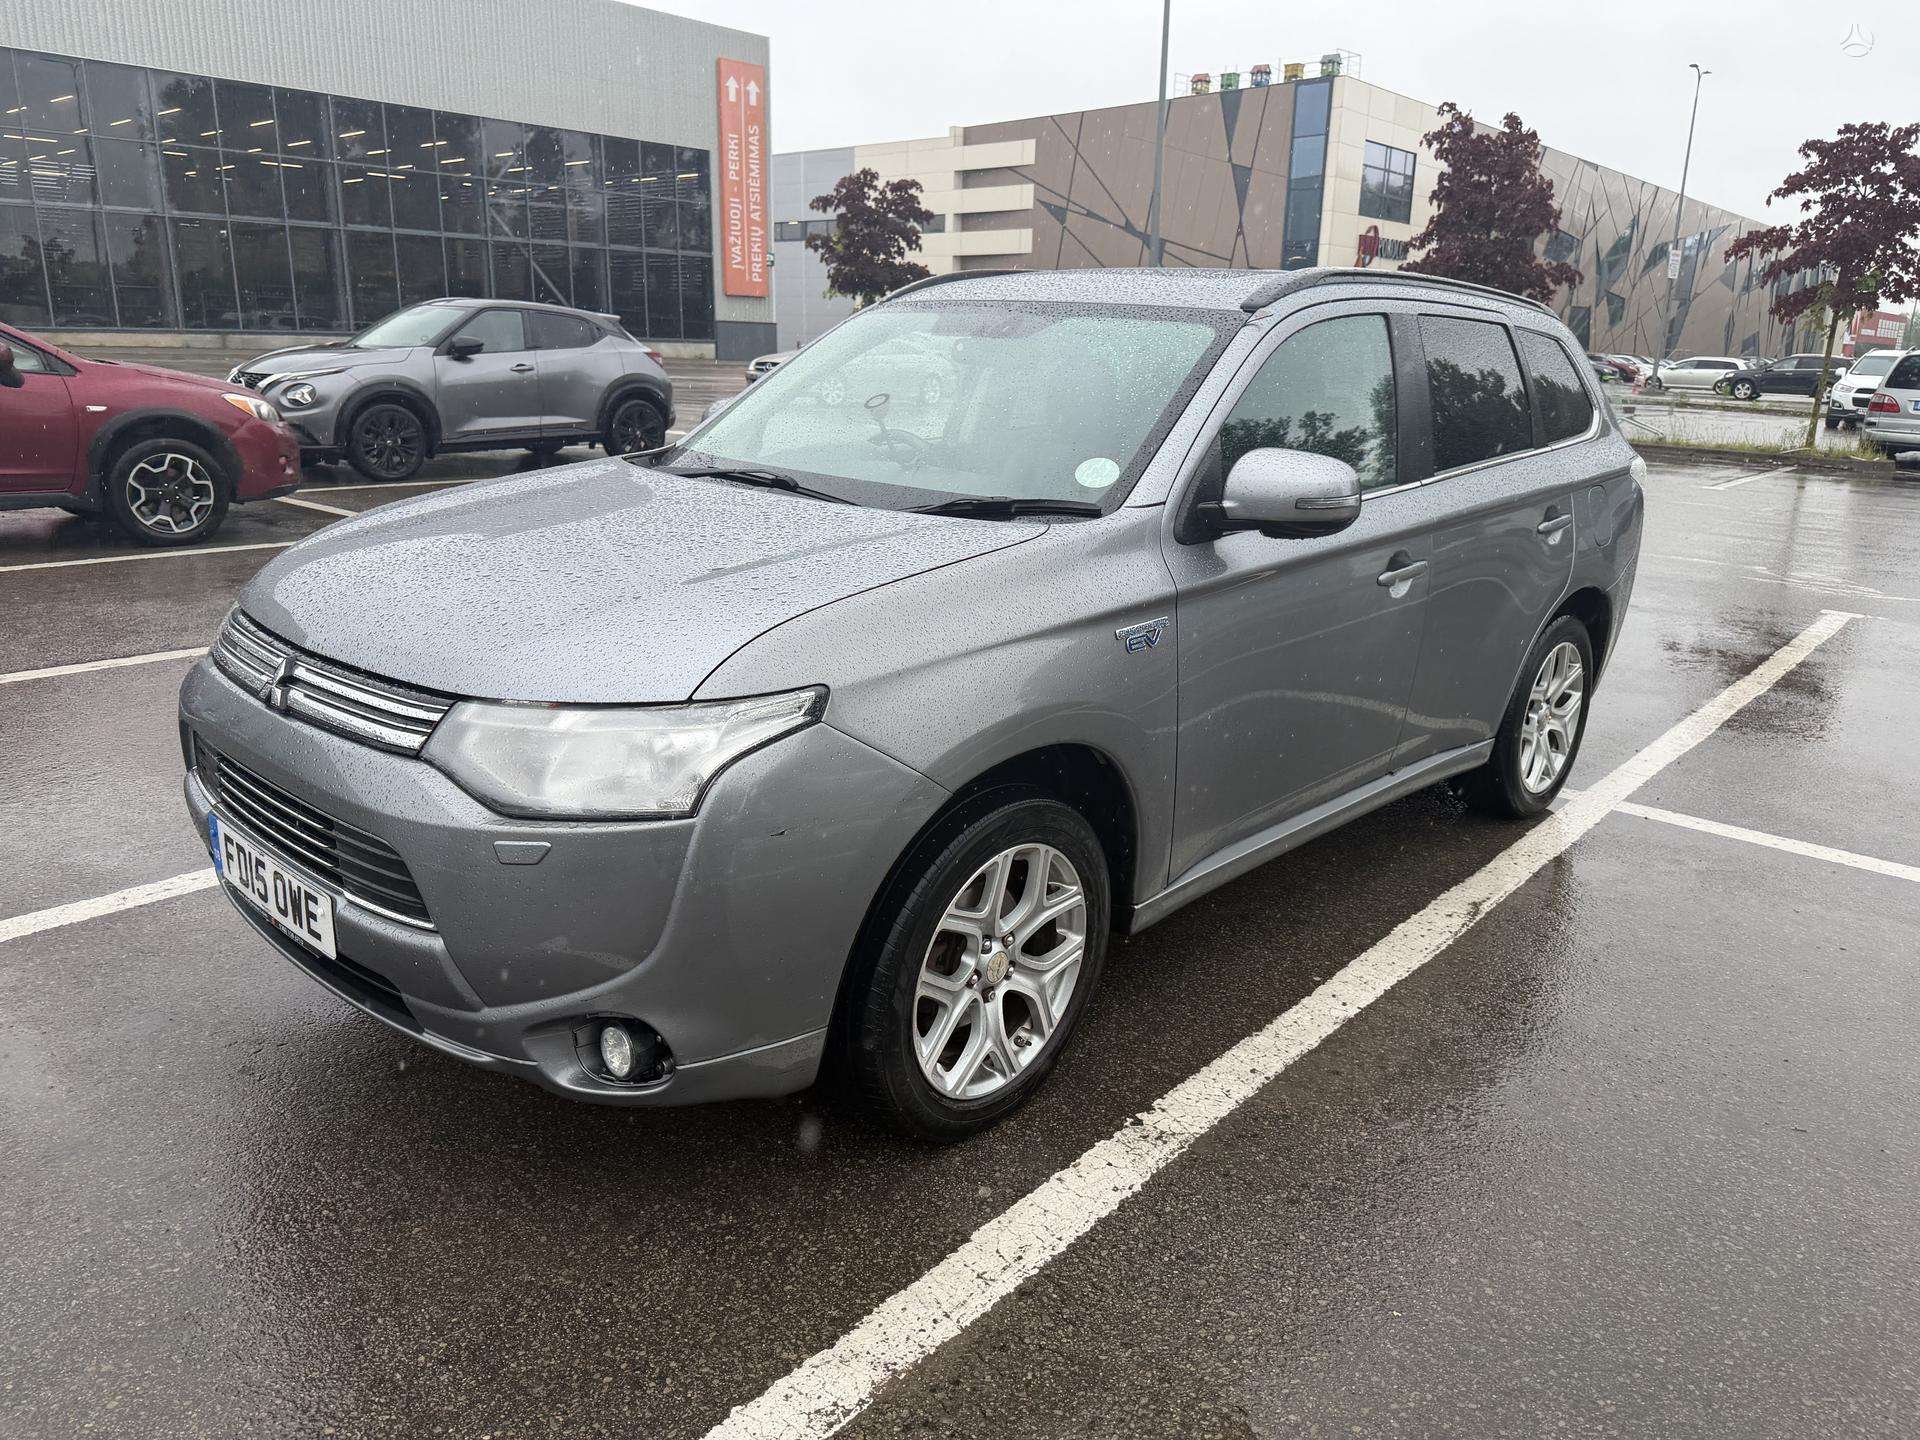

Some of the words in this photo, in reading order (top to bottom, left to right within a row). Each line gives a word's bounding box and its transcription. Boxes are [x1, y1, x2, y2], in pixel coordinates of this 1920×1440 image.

[728, 133, 740, 180] PERKI
[747, 125, 761, 221] ATSIĖMIMAS
[728, 197, 745, 270] ĮVAŽIUOJI
[751, 226, 764, 282] PREKIŲ
[223, 832, 269, 904] FD15
[273, 869, 322, 942] OWE
